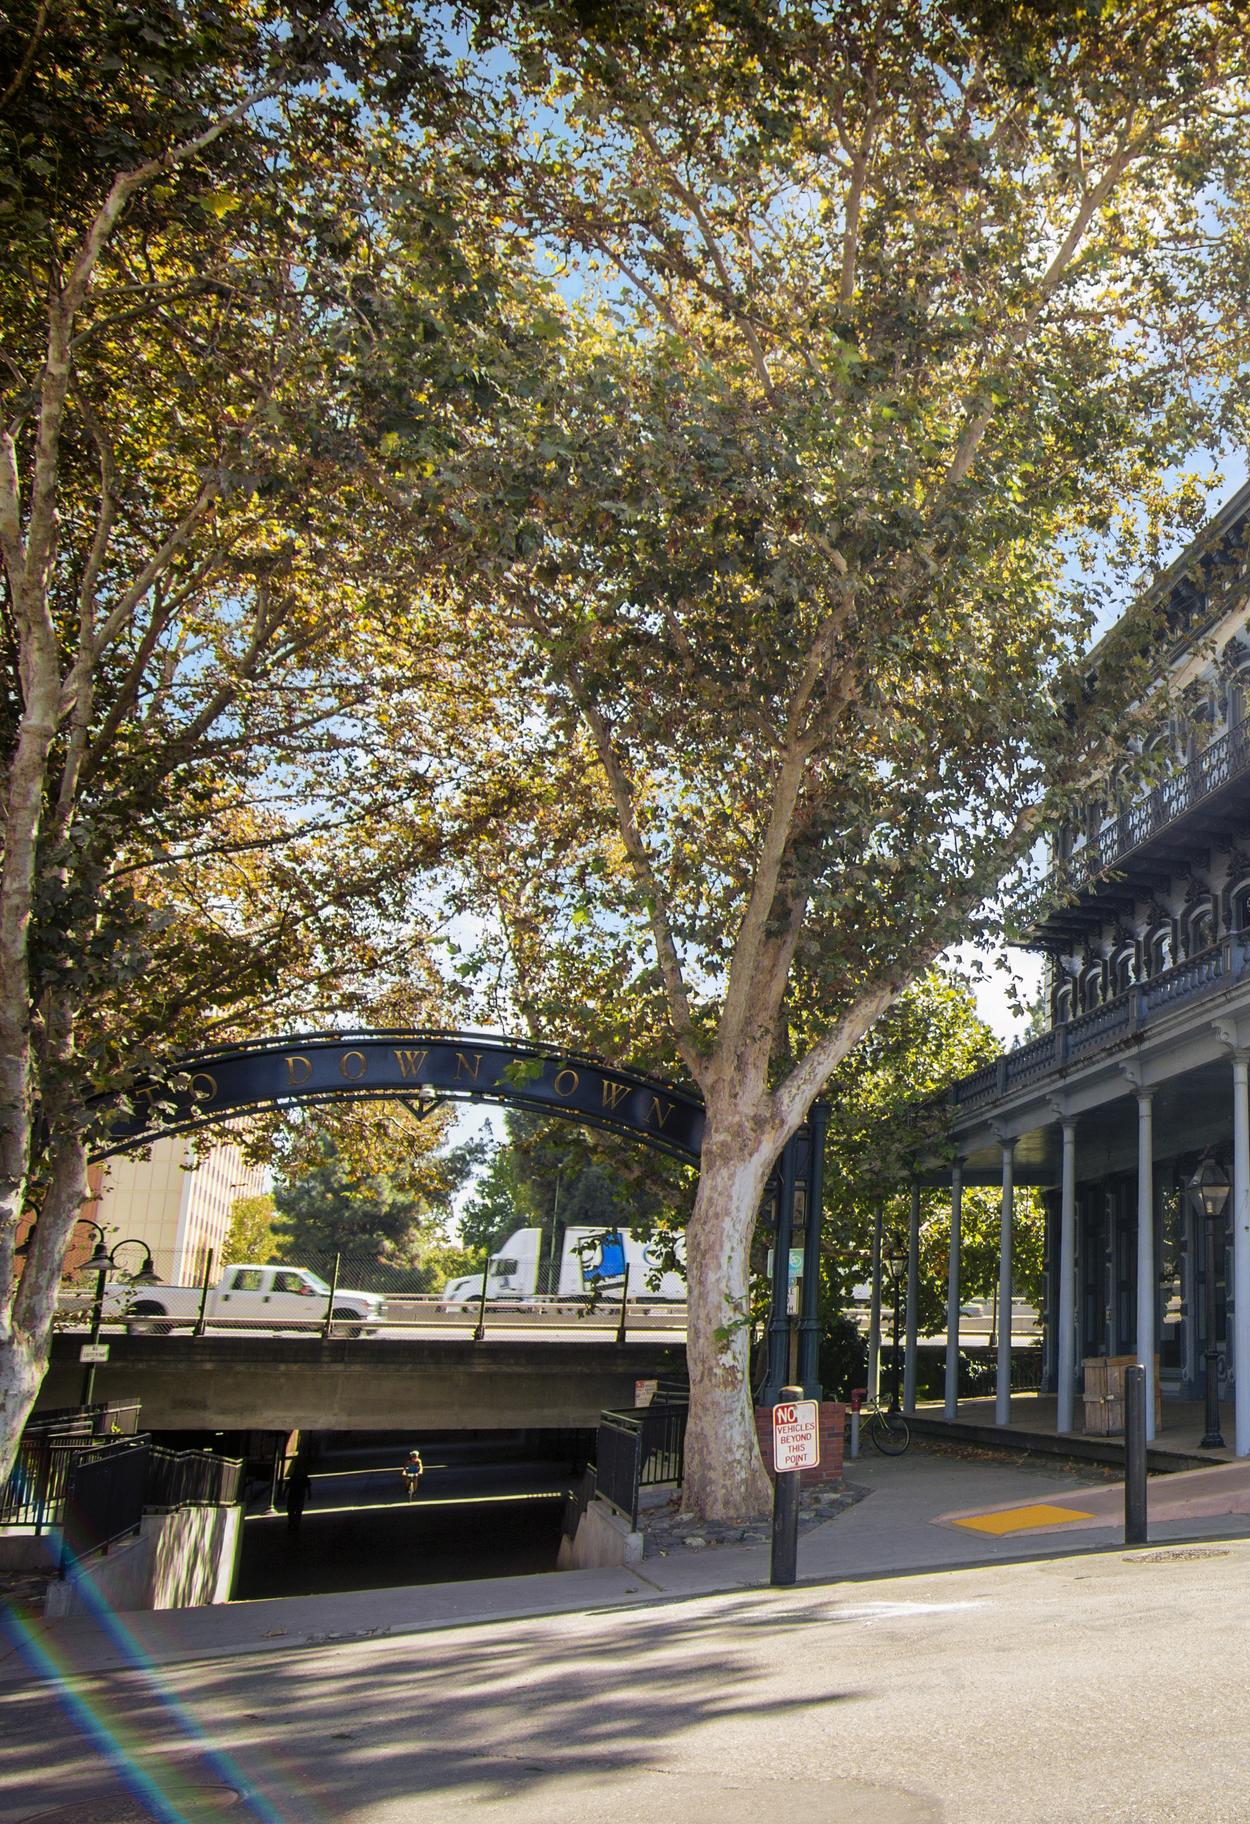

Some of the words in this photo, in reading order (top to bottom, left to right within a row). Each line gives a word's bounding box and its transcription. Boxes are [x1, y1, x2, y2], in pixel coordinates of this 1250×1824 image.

[284, 1049, 676, 1129] DOWNOWN
[776, 1406, 796, 1424] NO
[777, 1423, 815, 1434] VEHICLES
[780, 1433, 811, 1445] BEYOND
[787, 1443, 805, 1453] THIS
[784, 1453, 807, 1464] POINT
